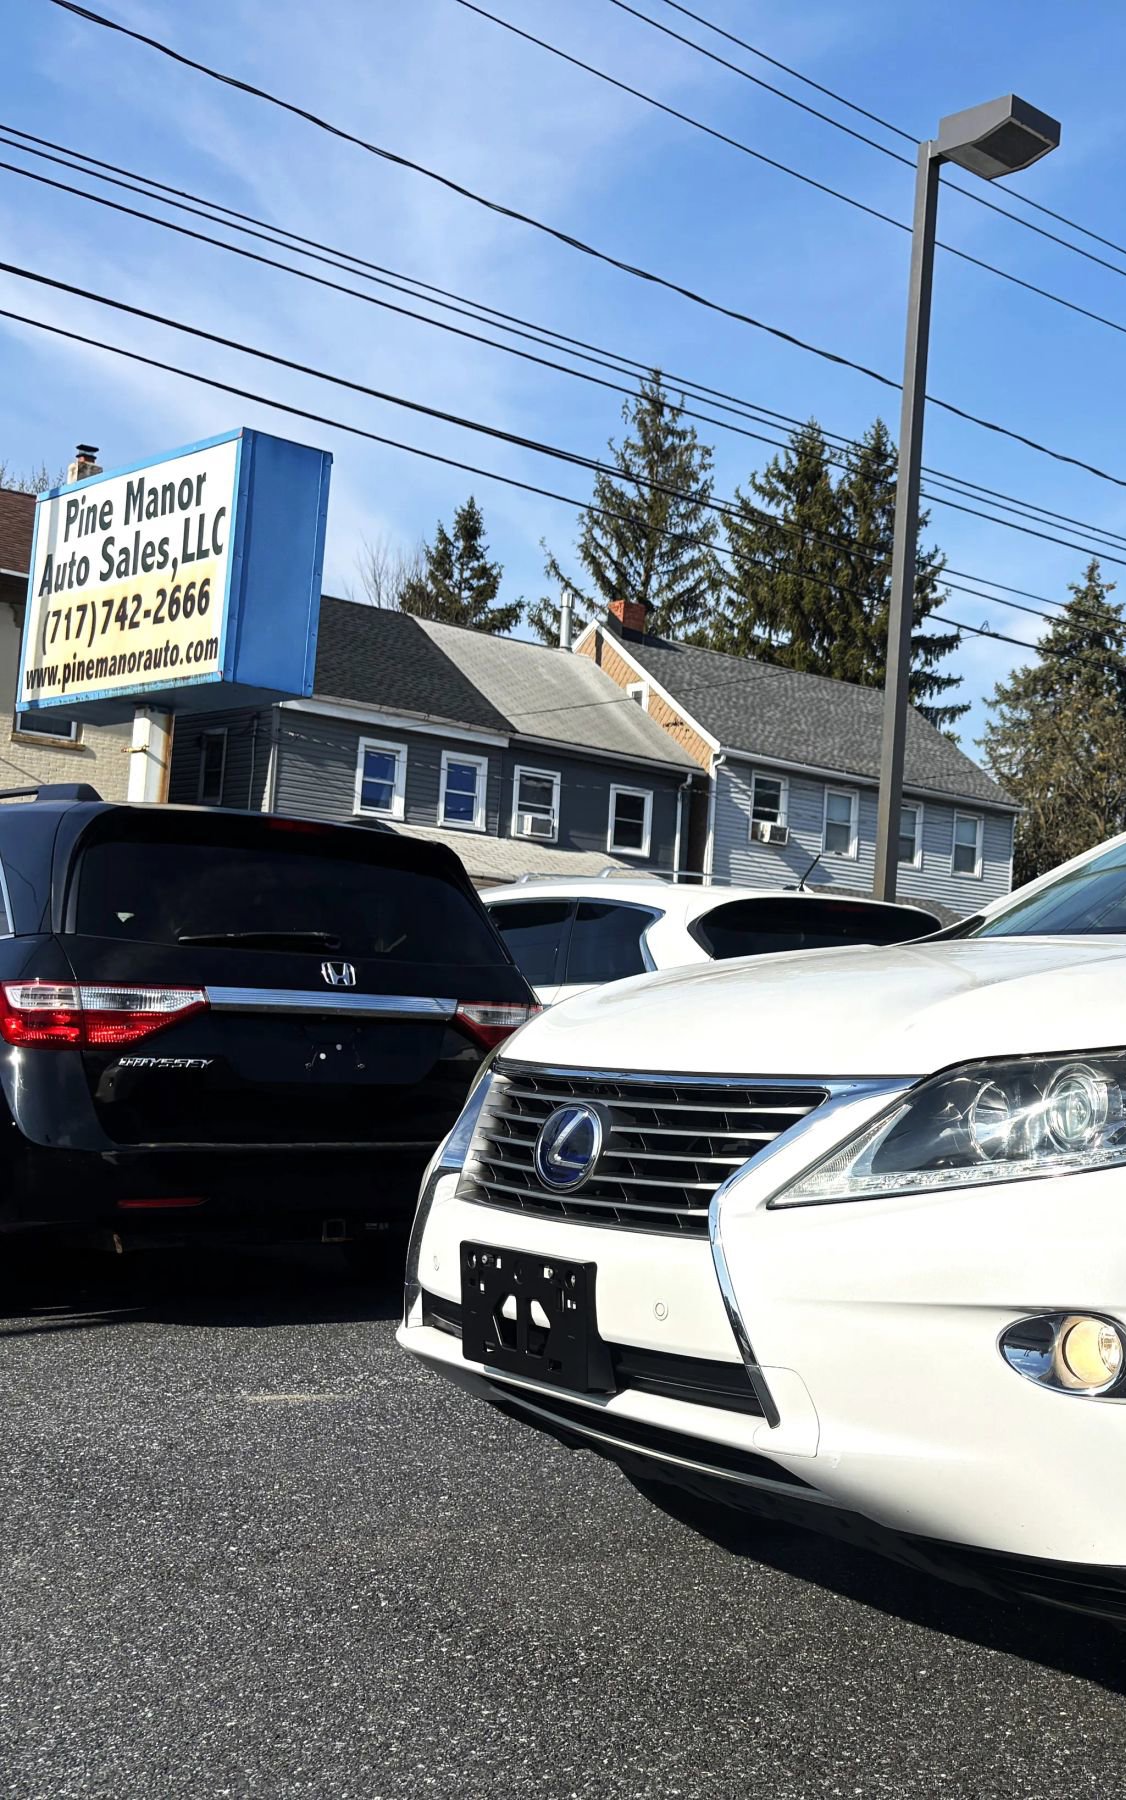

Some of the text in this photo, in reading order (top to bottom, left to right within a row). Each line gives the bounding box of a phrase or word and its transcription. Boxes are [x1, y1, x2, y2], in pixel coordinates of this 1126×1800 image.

[65, 471, 207, 543] Pine Manor
[38, 553, 90, 597] Auto
[25, 636, 219, 693] www.pinemanorauto.com
